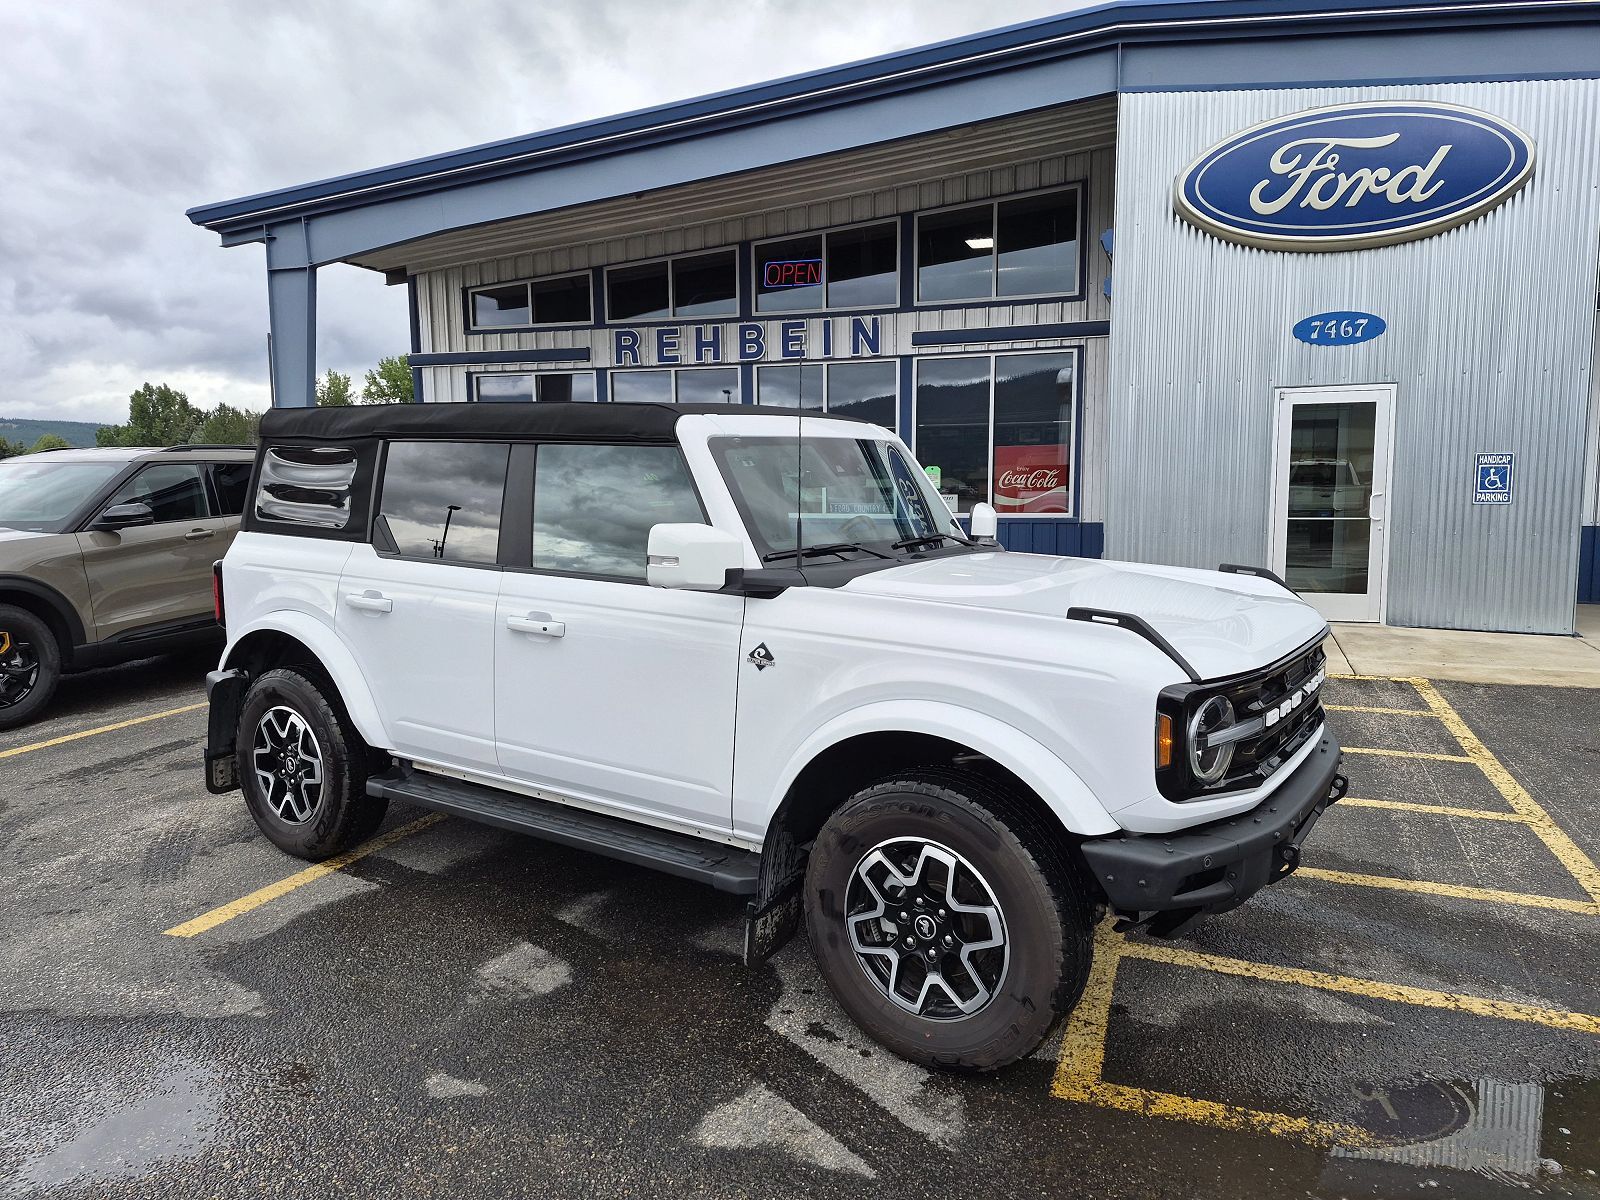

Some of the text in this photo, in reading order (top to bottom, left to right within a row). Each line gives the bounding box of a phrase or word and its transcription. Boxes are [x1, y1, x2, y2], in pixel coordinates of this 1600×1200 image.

[1250, 132, 1453, 216] Ford
[767, 263, 821, 285] OPEN
[1310, 318, 1369, 339] 7467
[614, 315, 881, 366] REHBEIN
[1479, 455, 1511, 464] HANDICAP
[998, 469, 1062, 489] Coca-Cola
[1476, 493, 1509, 502] PARKING
